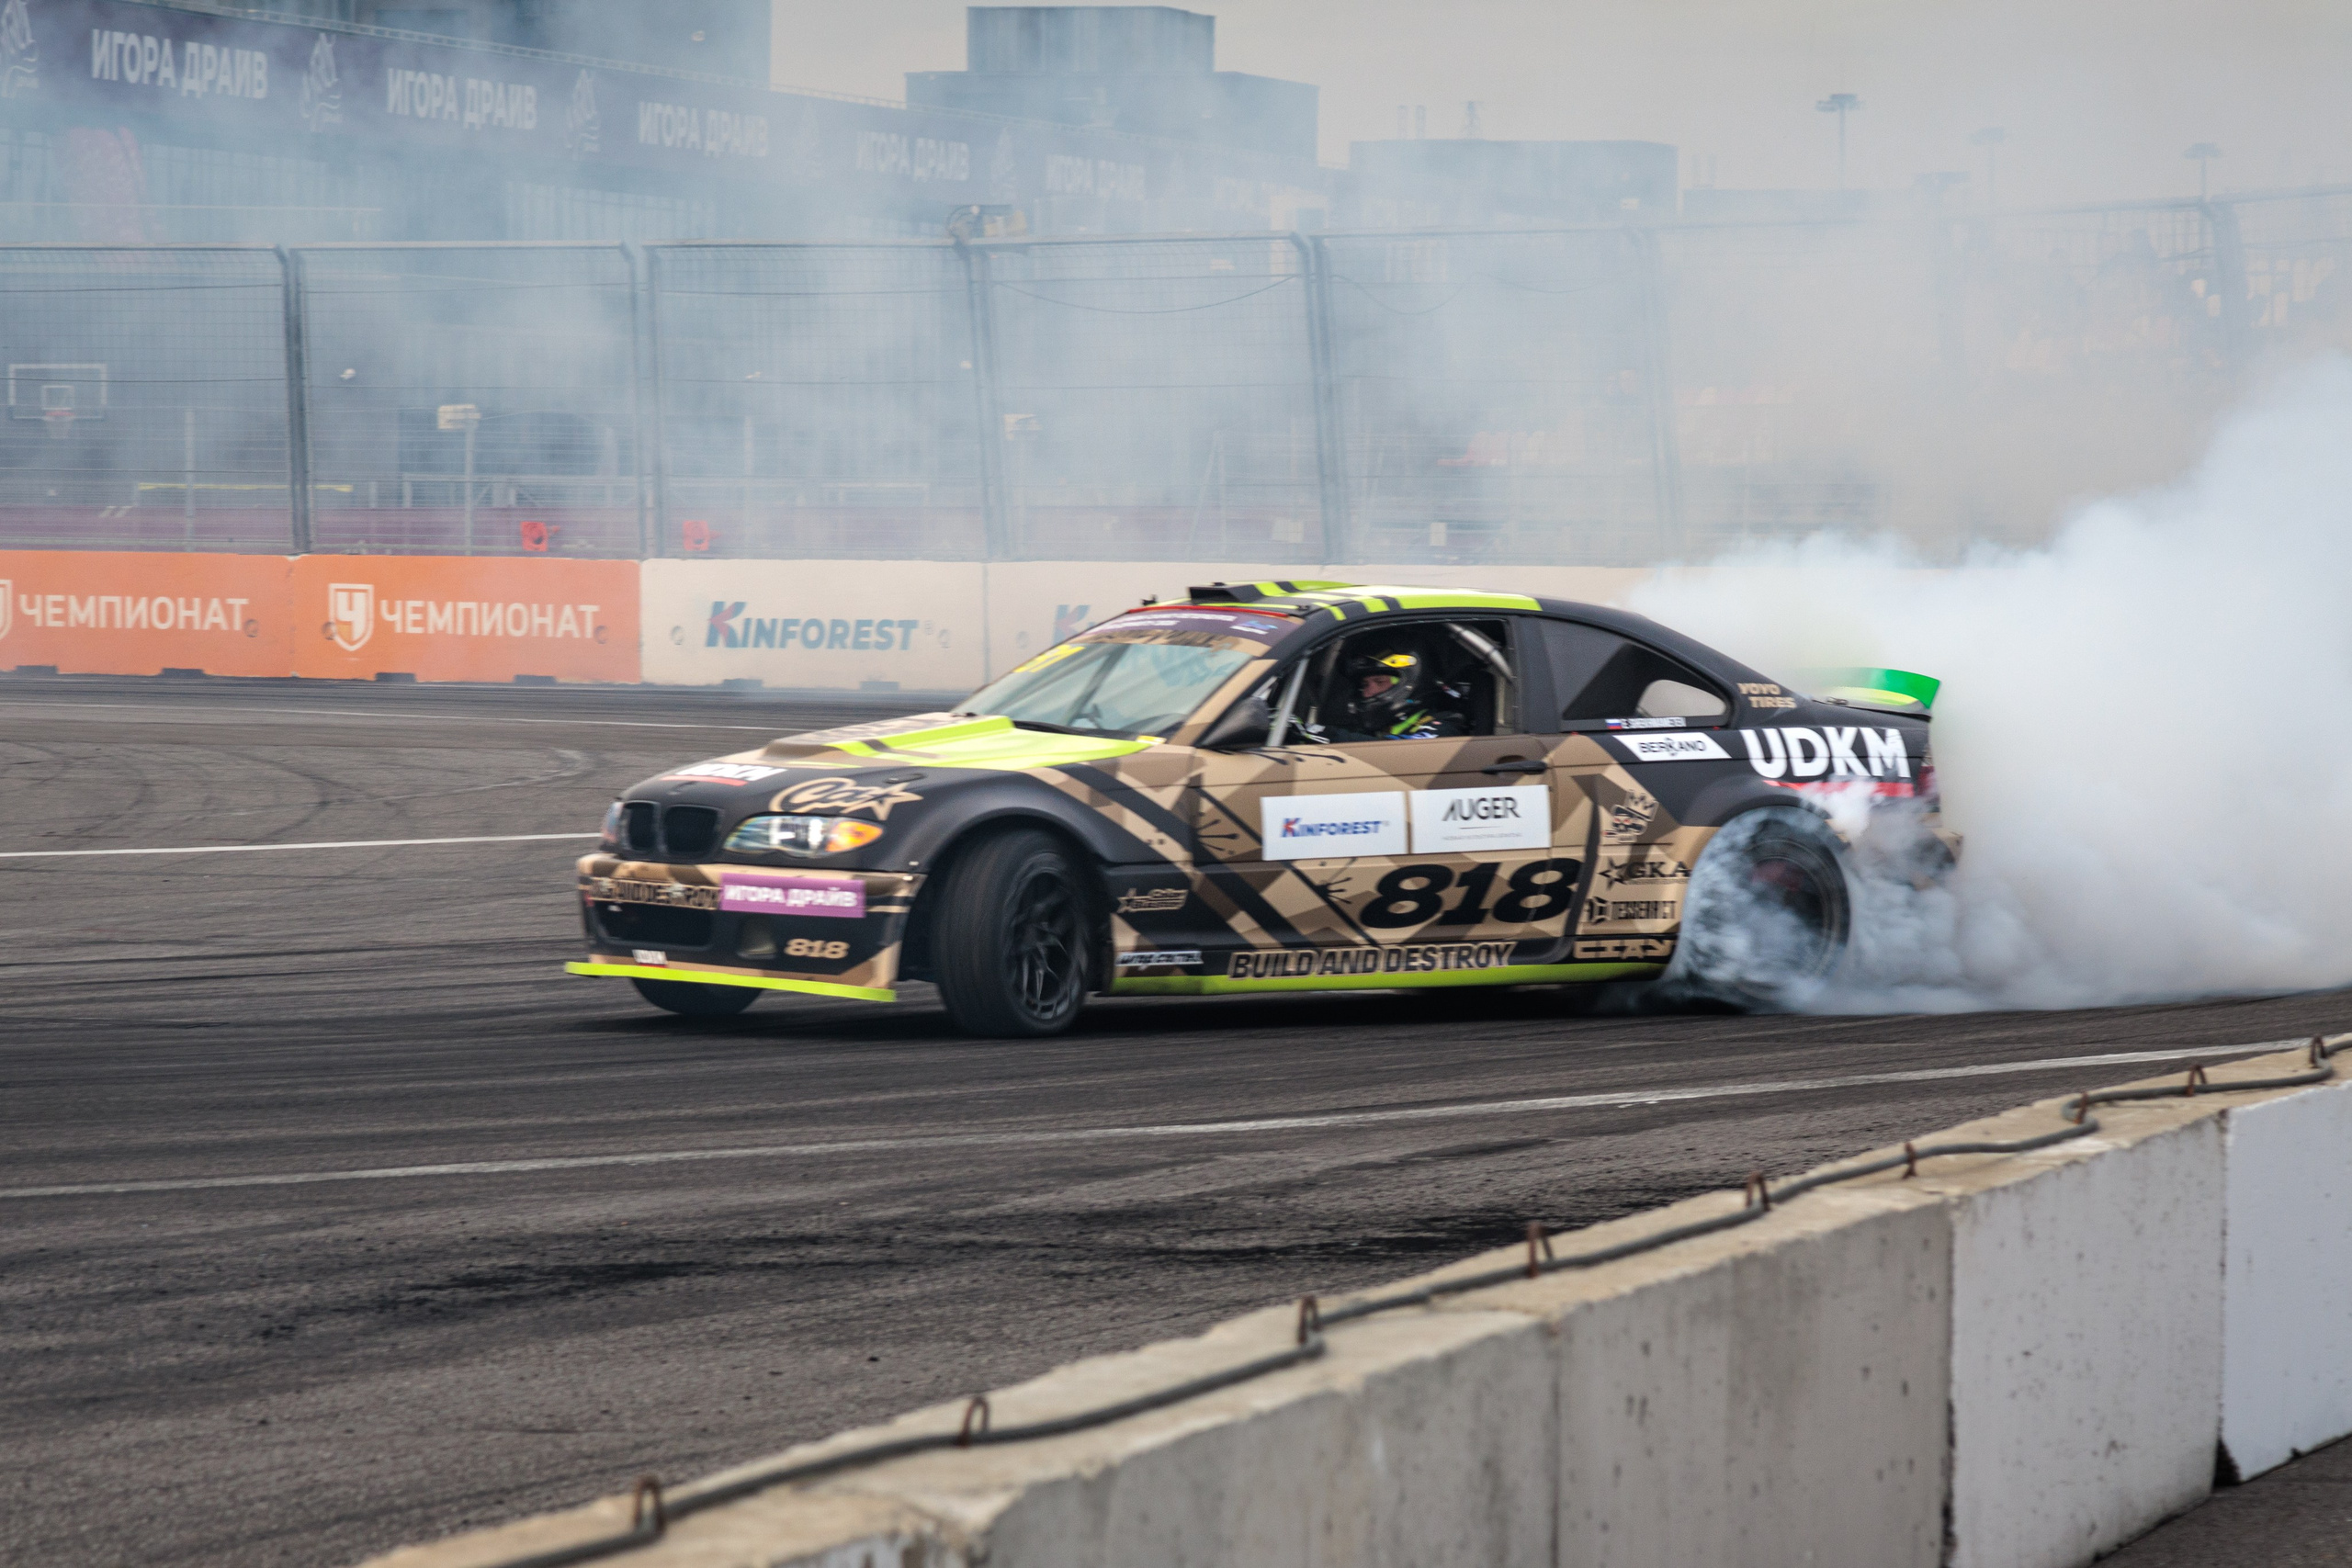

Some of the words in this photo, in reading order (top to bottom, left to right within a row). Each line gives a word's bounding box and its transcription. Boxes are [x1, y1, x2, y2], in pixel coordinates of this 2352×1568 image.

[91, 28, 176, 88] ИГОРА
[387, 68, 458, 121] ИГОРА
[19, 594, 249, 631] ЧЕМПИОНАТ
[380, 600, 600, 638] ЧЕМПИОНАТ
[705, 601, 919, 651] KINFOREST
[1749, 696, 1798, 708] TIRES
[1739, 726, 1911, 779] UDKM
[1442, 796, 1521, 821] AUGER
[1281, 818, 1381, 838] KINFOREST
[723, 885, 785, 904] ИГОРА
[1359, 857, 1584, 929] 818
[784, 938, 850, 959] 818
[1229, 950, 1314, 980] BUILD
[1316, 947, 1382, 976] AND
[1382, 942, 1517, 973] DESTROY
